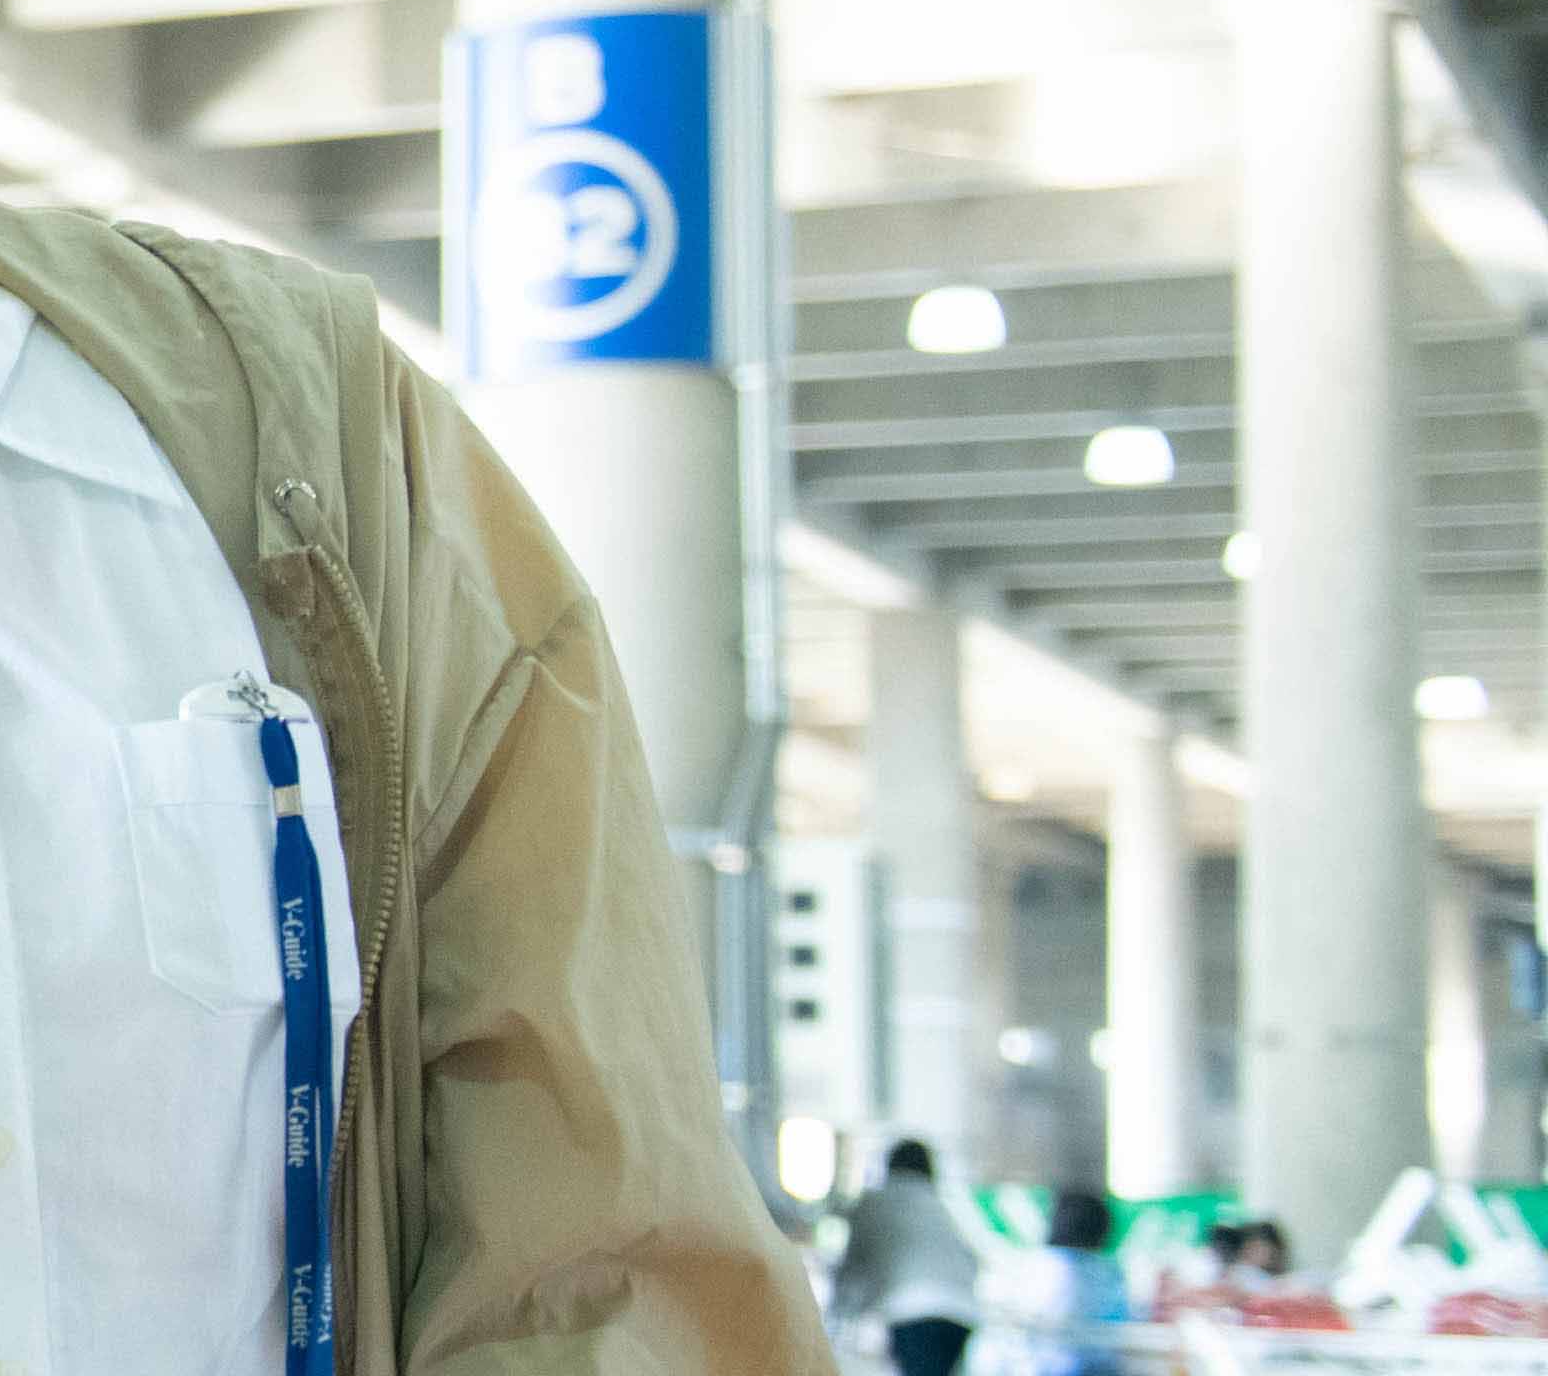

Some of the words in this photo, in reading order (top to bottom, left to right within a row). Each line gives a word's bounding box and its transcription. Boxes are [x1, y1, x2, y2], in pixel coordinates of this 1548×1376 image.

[282, 897, 308, 981] V-Guide
[287, 1084, 309, 1168] V-Guide
[290, 1263, 313, 1348] V-Guide
